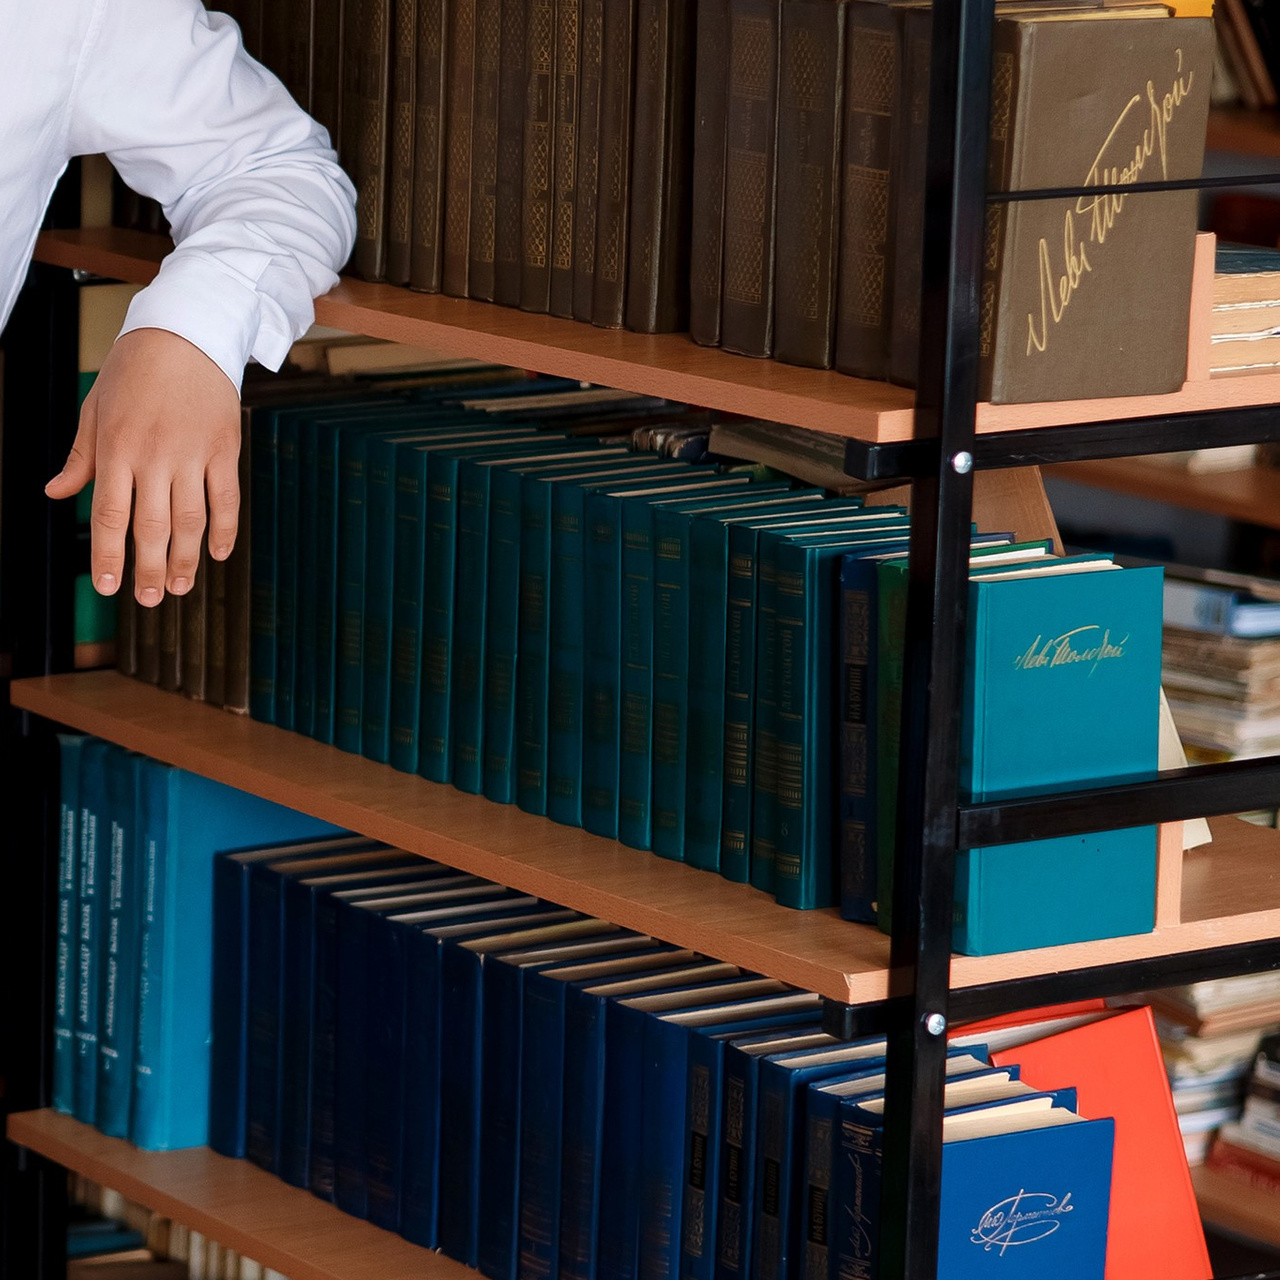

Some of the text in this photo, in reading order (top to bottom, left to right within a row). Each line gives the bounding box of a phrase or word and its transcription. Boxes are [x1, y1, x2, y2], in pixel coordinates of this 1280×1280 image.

[781, 823, 788, 836] 8
[59, 899, 68, 1015] АЛЕКСАНДР БЛОК
[81, 904, 90, 1022] АЛЕКСАНДР БЛОК
[109, 917, 118, 953] БЛОК
